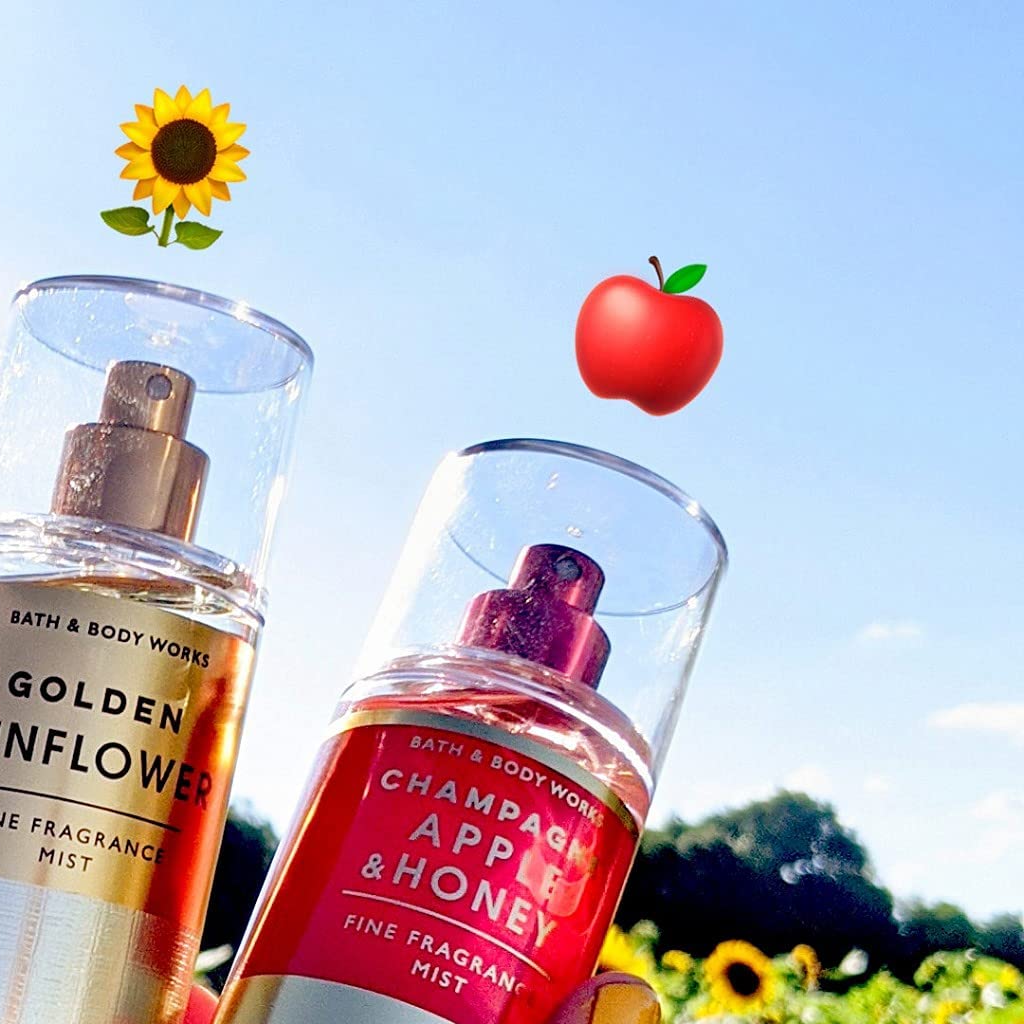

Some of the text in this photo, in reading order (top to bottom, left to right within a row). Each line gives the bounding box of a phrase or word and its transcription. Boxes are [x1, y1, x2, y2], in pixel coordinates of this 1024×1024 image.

[10, 610, 210, 669] BATH & BODY WORKS
[8, 670, 184, 735] GOLDEN
[410, 735, 605, 828] BATH & BODY WORKS
[30, 818, 166, 866] FRAGRANCE
[380, 769, 594, 870] CHAMPAGN
[37, 846, 94, 873] MIST
[343, 914, 527, 996] FINE FRAGRANC
[410, 959, 469, 994] MIST
